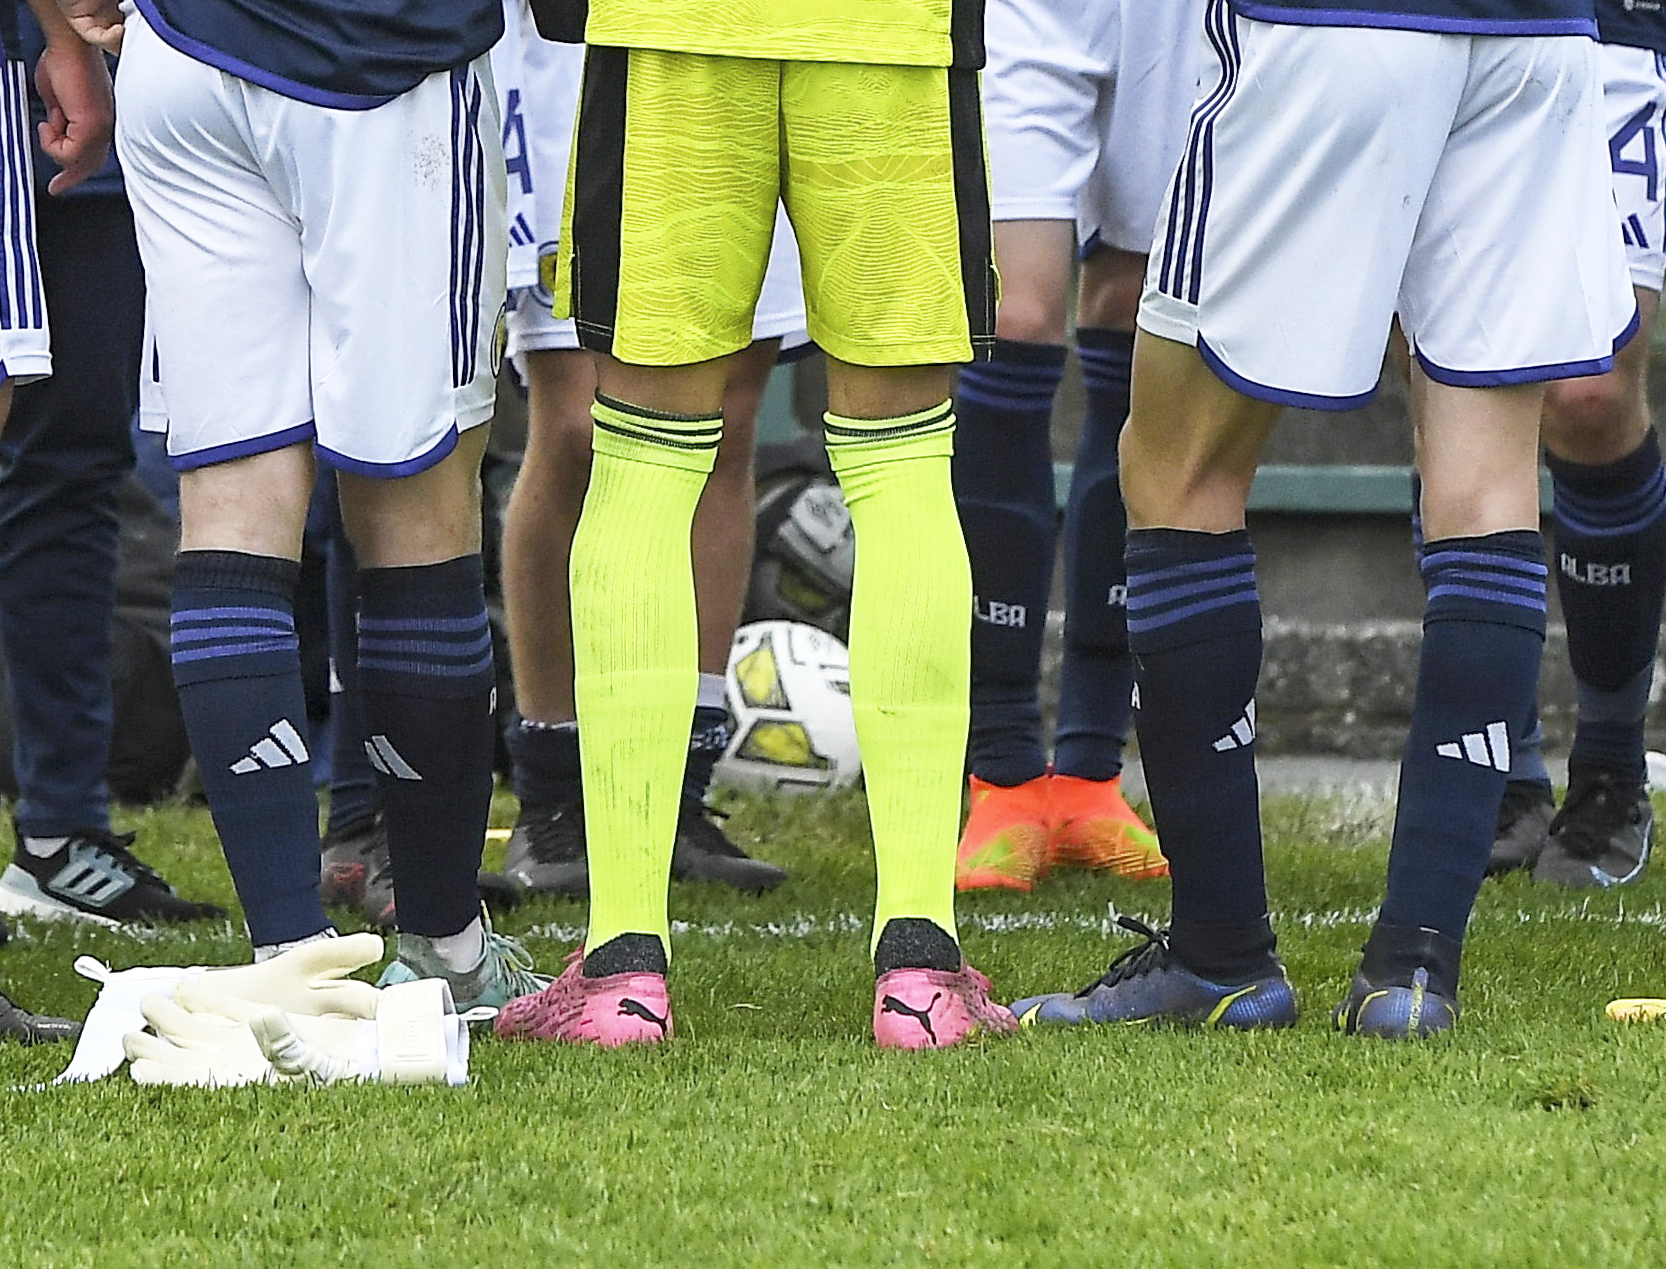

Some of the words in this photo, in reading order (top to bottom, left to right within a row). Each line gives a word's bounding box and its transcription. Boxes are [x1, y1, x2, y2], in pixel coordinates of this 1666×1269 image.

[1608, 100, 1658, 202] 4
[1560, 553, 1631, 586] ALBA
[973, 595, 1027, 627] LBA
